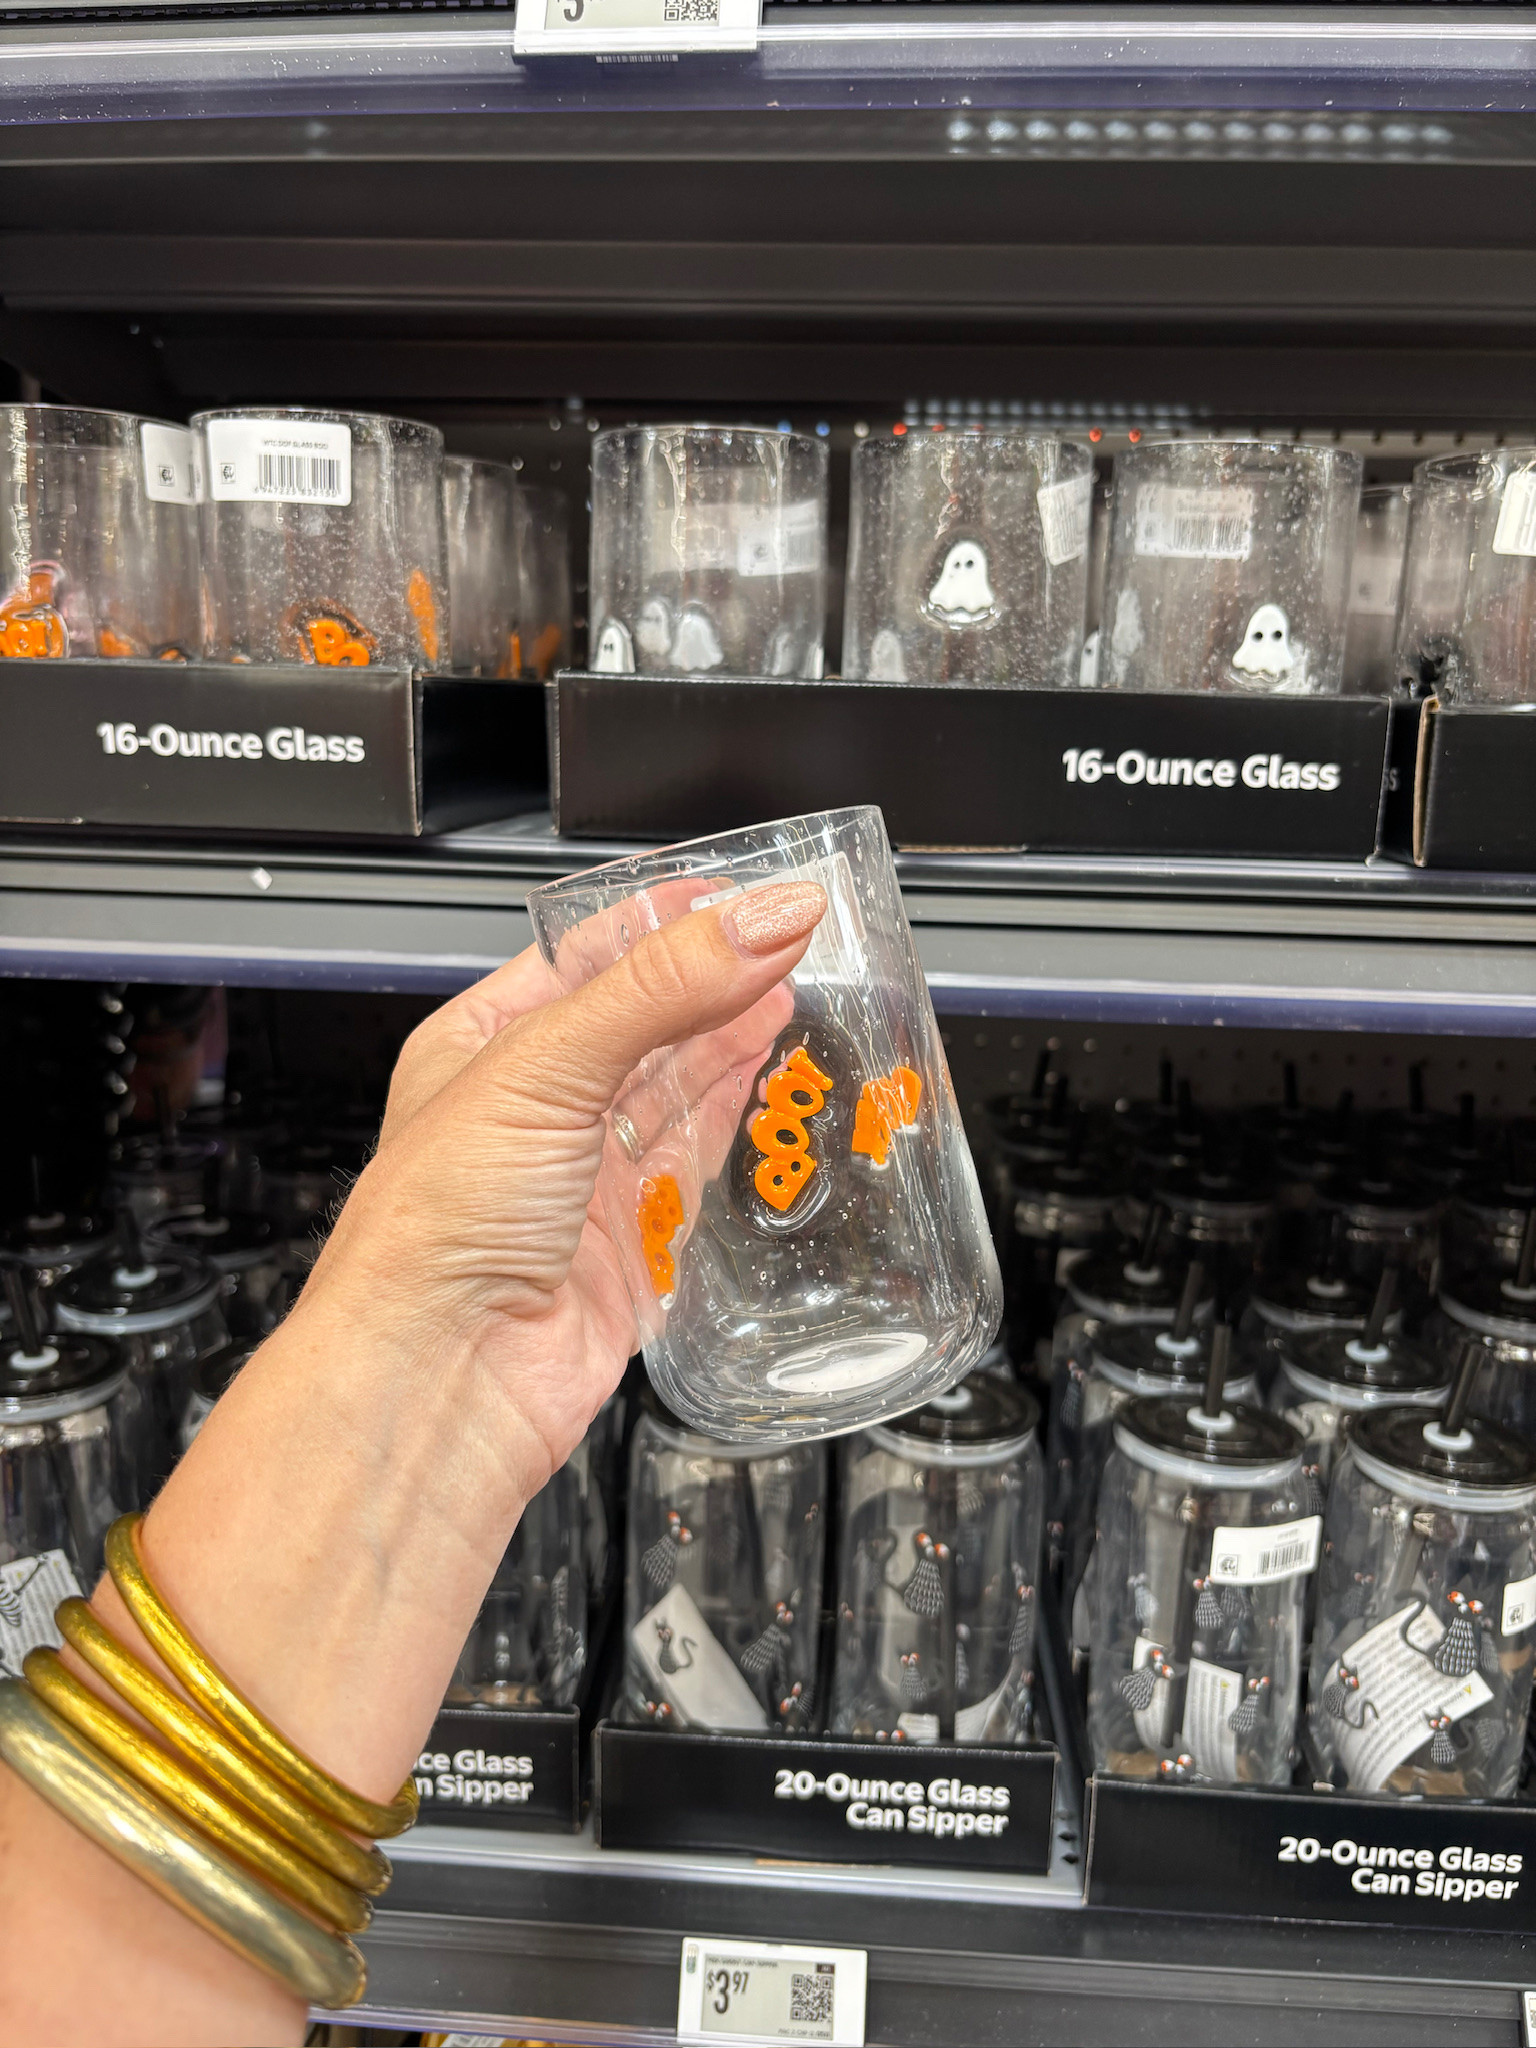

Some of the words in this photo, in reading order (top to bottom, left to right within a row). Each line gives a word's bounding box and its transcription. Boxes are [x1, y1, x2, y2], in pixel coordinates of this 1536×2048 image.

[97, 723, 262, 760] 16-Ounce
[266, 728, 365, 763] Glass
[1062, 749, 1236, 787] 16-Ounce
[1241, 755, 1341, 791] Glass
[751, 1046, 833, 1212] BOO!
[413, 1752, 451, 1774] ce
[453, 1749, 533, 1775] Glass
[436, 1774, 533, 1804] Sipper
[774, 1769, 926, 1805] 20-Ounce
[927, 1778, 1011, 1809] Glass
[846, 1803, 904, 1830] Can
[907, 1804, 1010, 1838] Sipper
[1277, 1836, 1433, 1870] 20-Ounce
[1438, 1846, 1523, 1876] Glass
[1351, 1868, 1410, 1895] Can
[1414, 1871, 1521, 1903] Sipper
